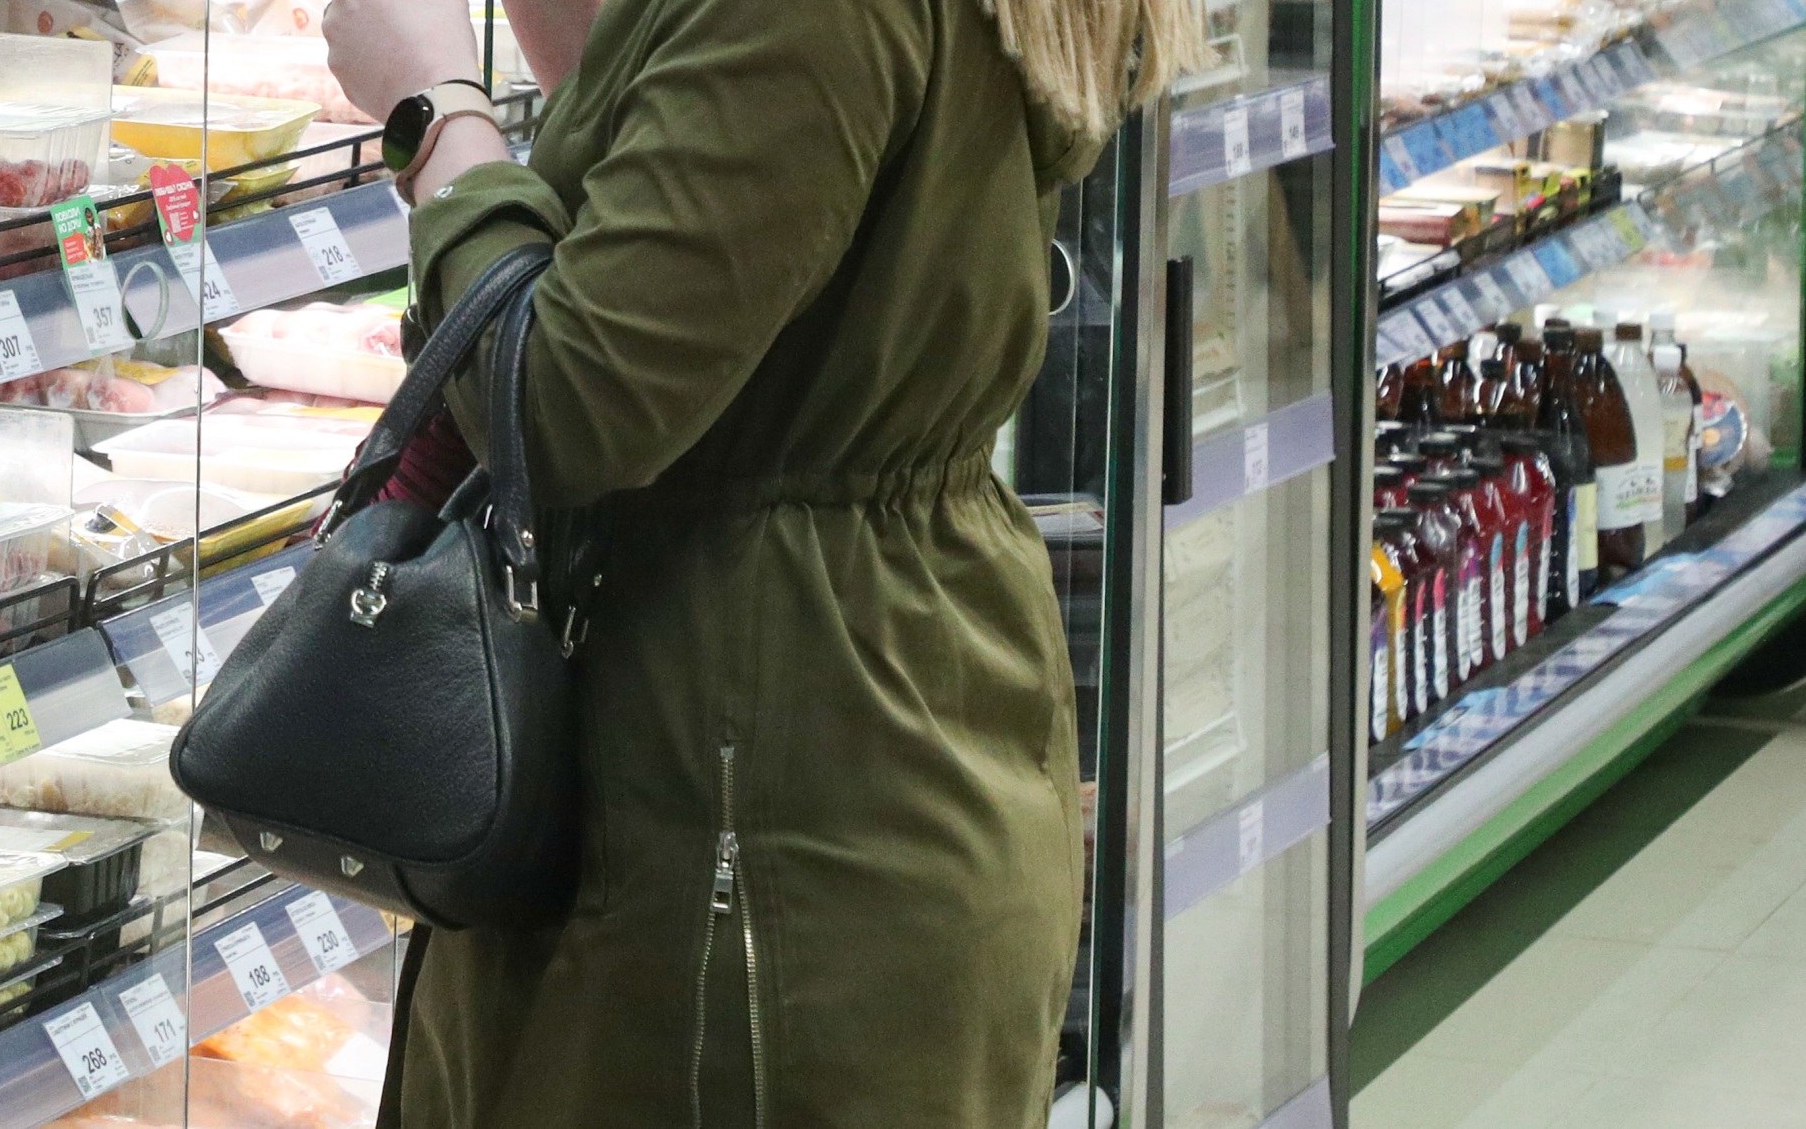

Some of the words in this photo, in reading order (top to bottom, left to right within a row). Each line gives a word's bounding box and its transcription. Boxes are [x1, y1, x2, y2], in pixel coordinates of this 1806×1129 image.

[321, 244, 345, 267] 218
[93, 305, 114, 329] 357
[6, 707, 30, 731] 223
[316, 929, 340, 955] 230
[248, 964, 272, 988] 188
[153, 1017, 177, 1045] 171
[81, 1047, 108, 1075] 268
